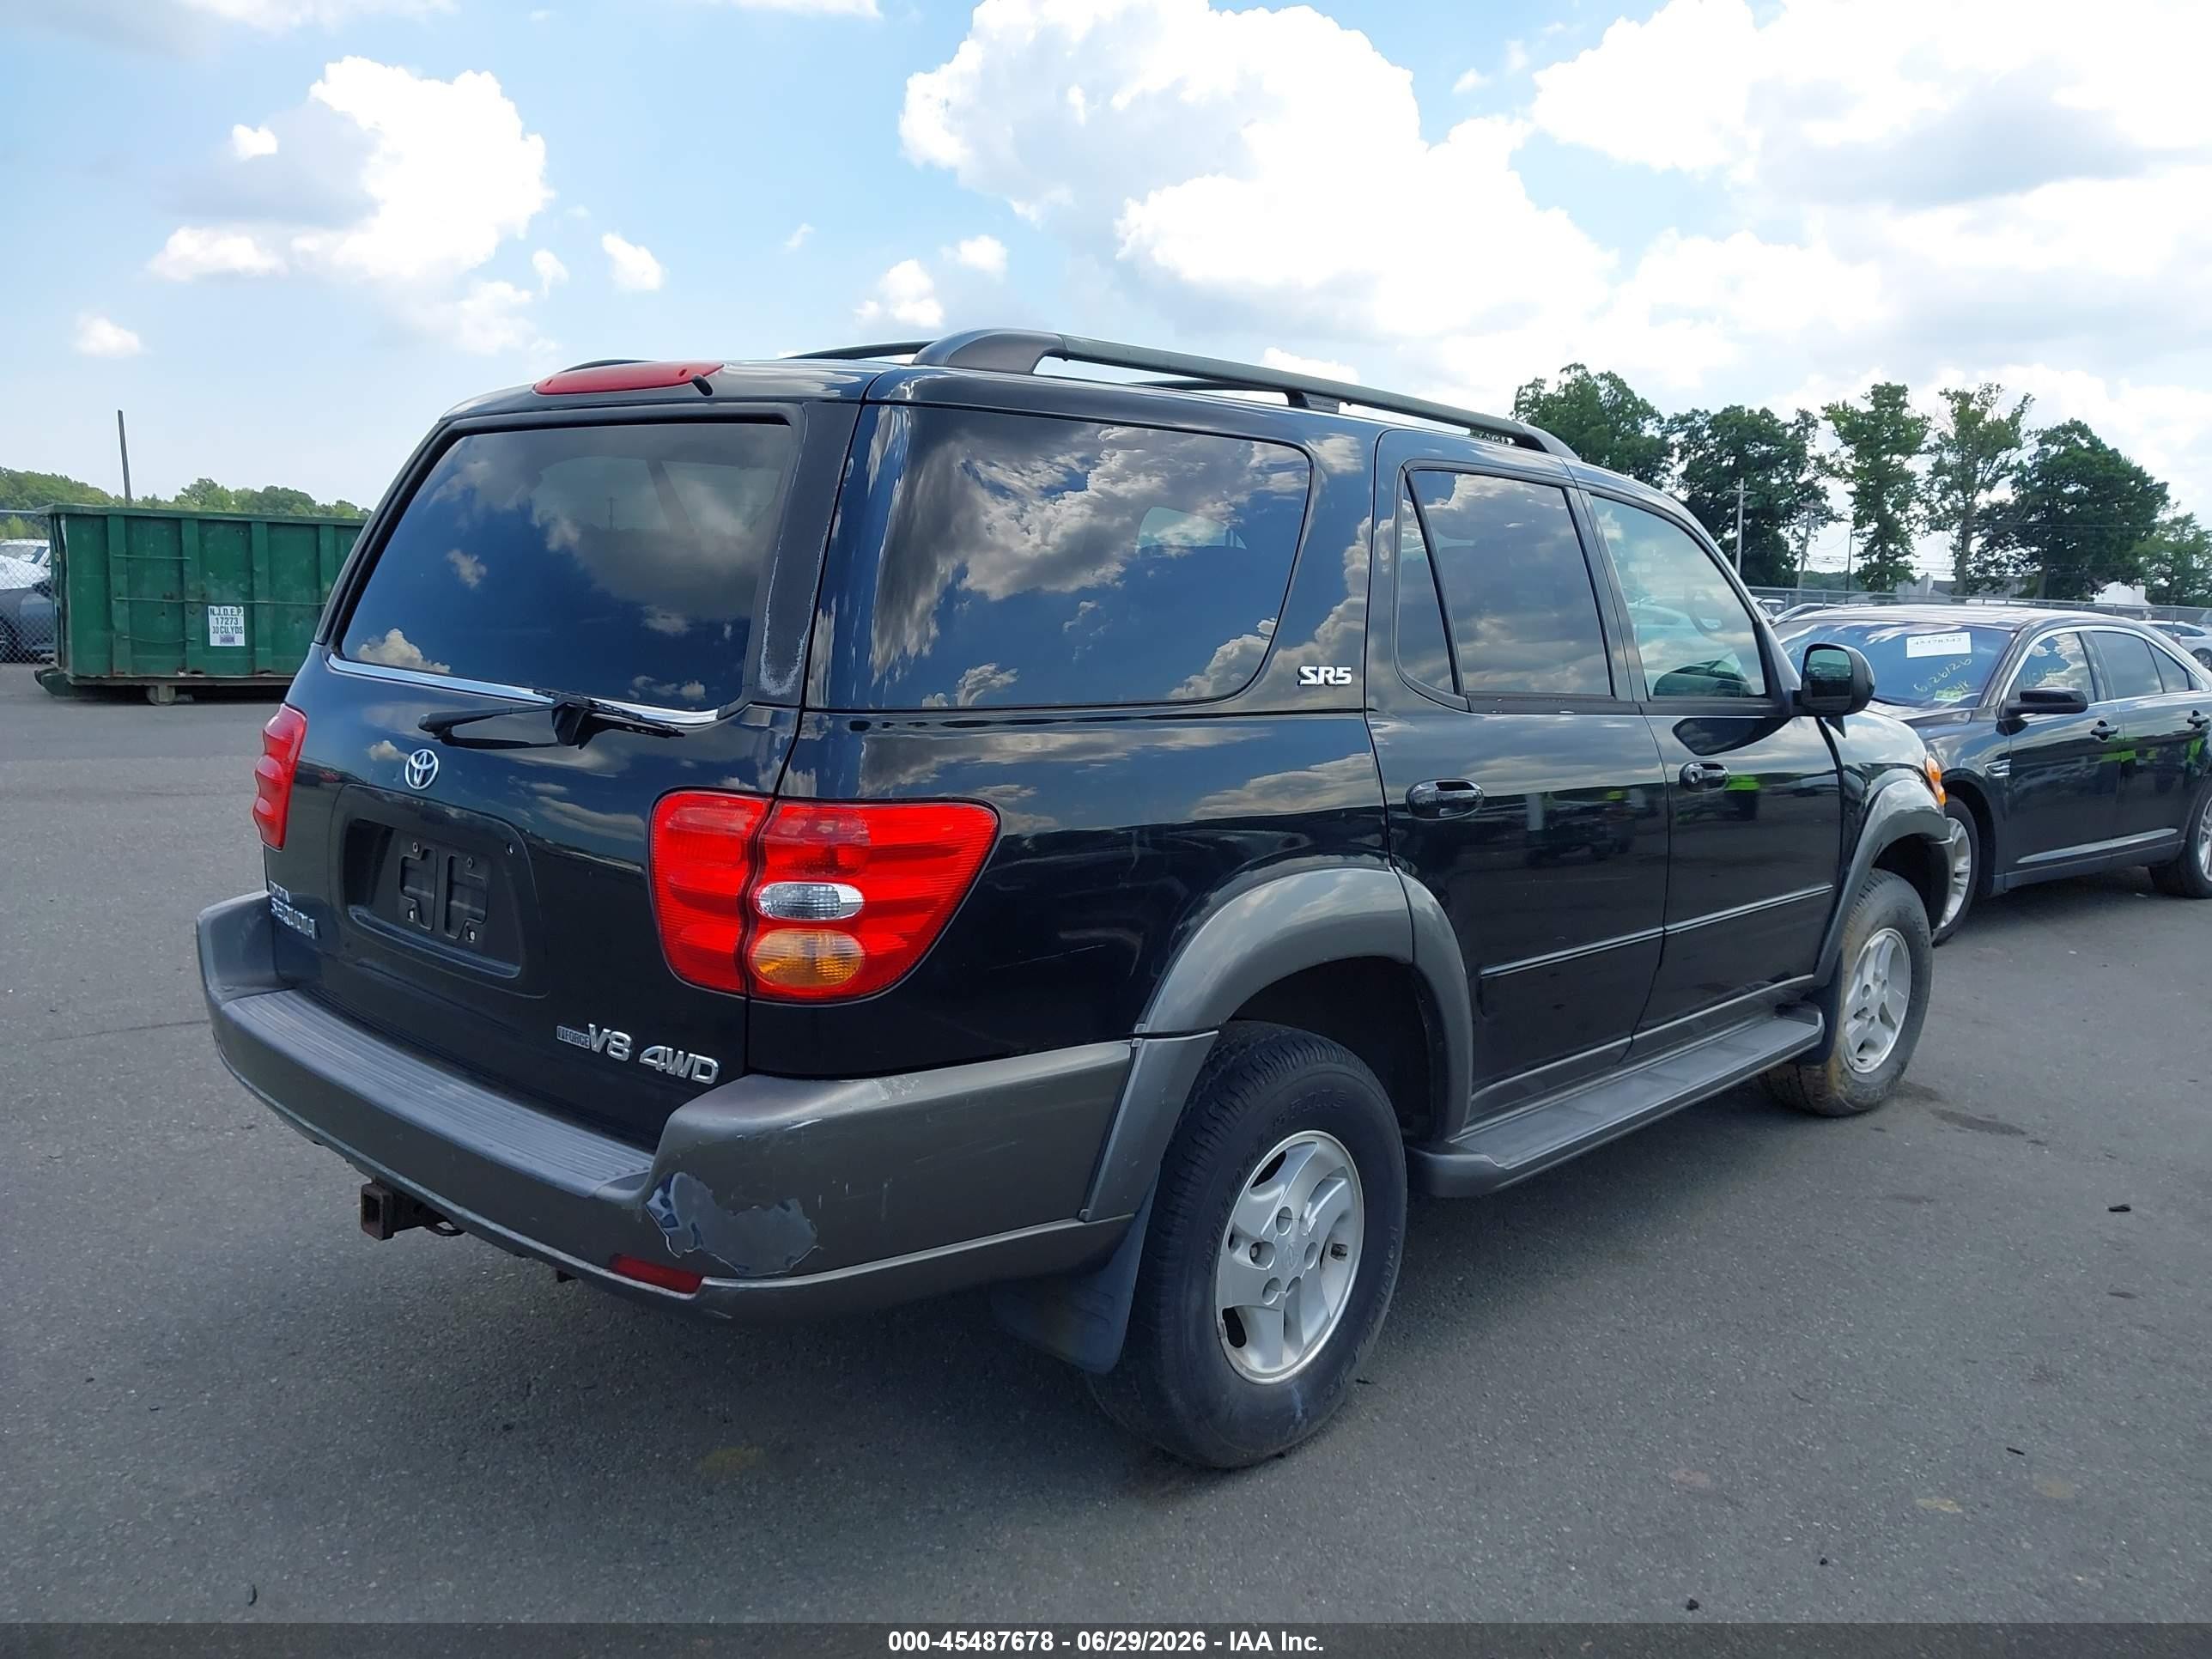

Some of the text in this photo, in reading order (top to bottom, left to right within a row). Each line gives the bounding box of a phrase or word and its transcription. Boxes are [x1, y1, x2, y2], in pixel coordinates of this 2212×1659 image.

[215, 617, 239, 626] 17273
[1297, 665, 1352, 686] SR5
[588, 1023, 633, 1062] V8
[639, 1045, 719, 1085] 4WD
